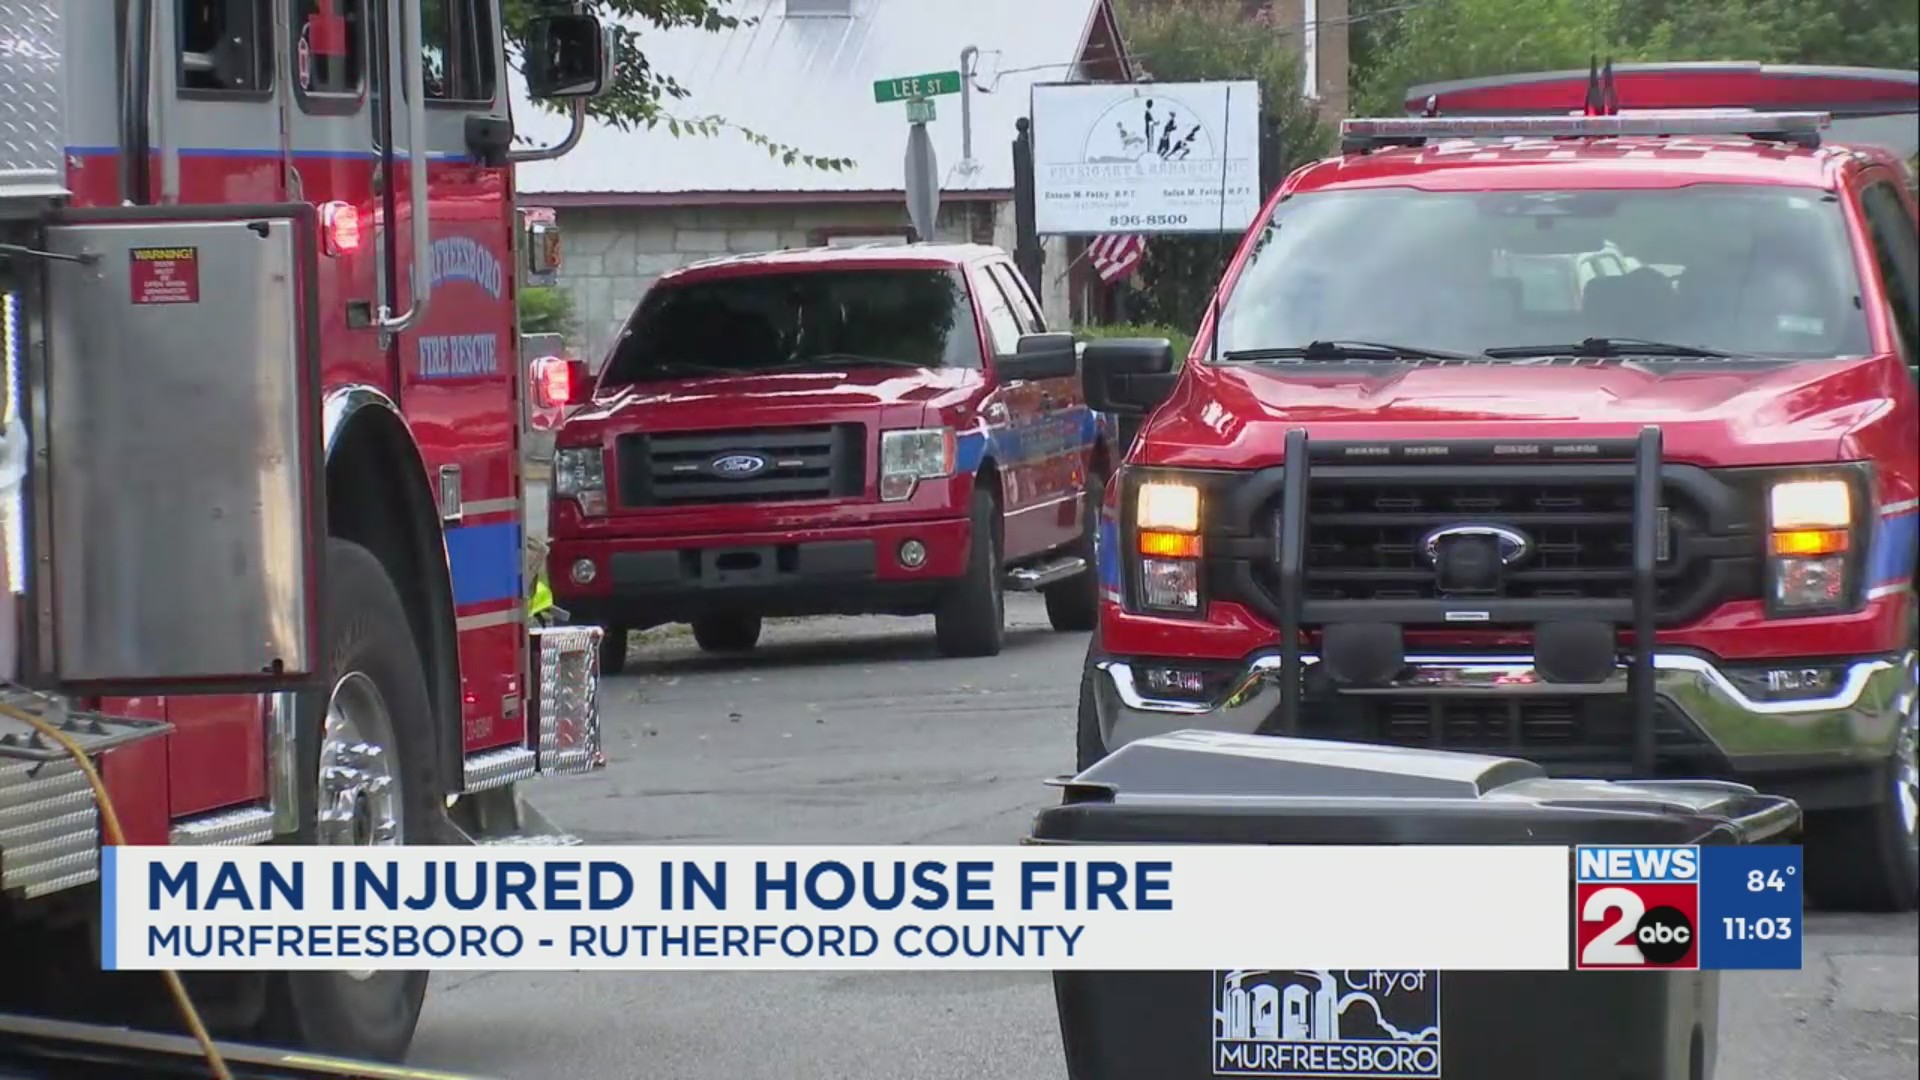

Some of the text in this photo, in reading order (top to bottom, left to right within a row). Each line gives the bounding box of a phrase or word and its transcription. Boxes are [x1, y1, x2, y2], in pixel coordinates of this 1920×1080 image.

[892, 79, 942, 98] LEE ST
[1109, 214, 1188, 227] 896-8500
[133, 248, 193, 260] WARNING!
[419, 333, 497, 378] FIRE RESCUE
[1344, 969, 1426, 997] City of
[1220, 1044, 1438, 1072] MURFREESBORO
